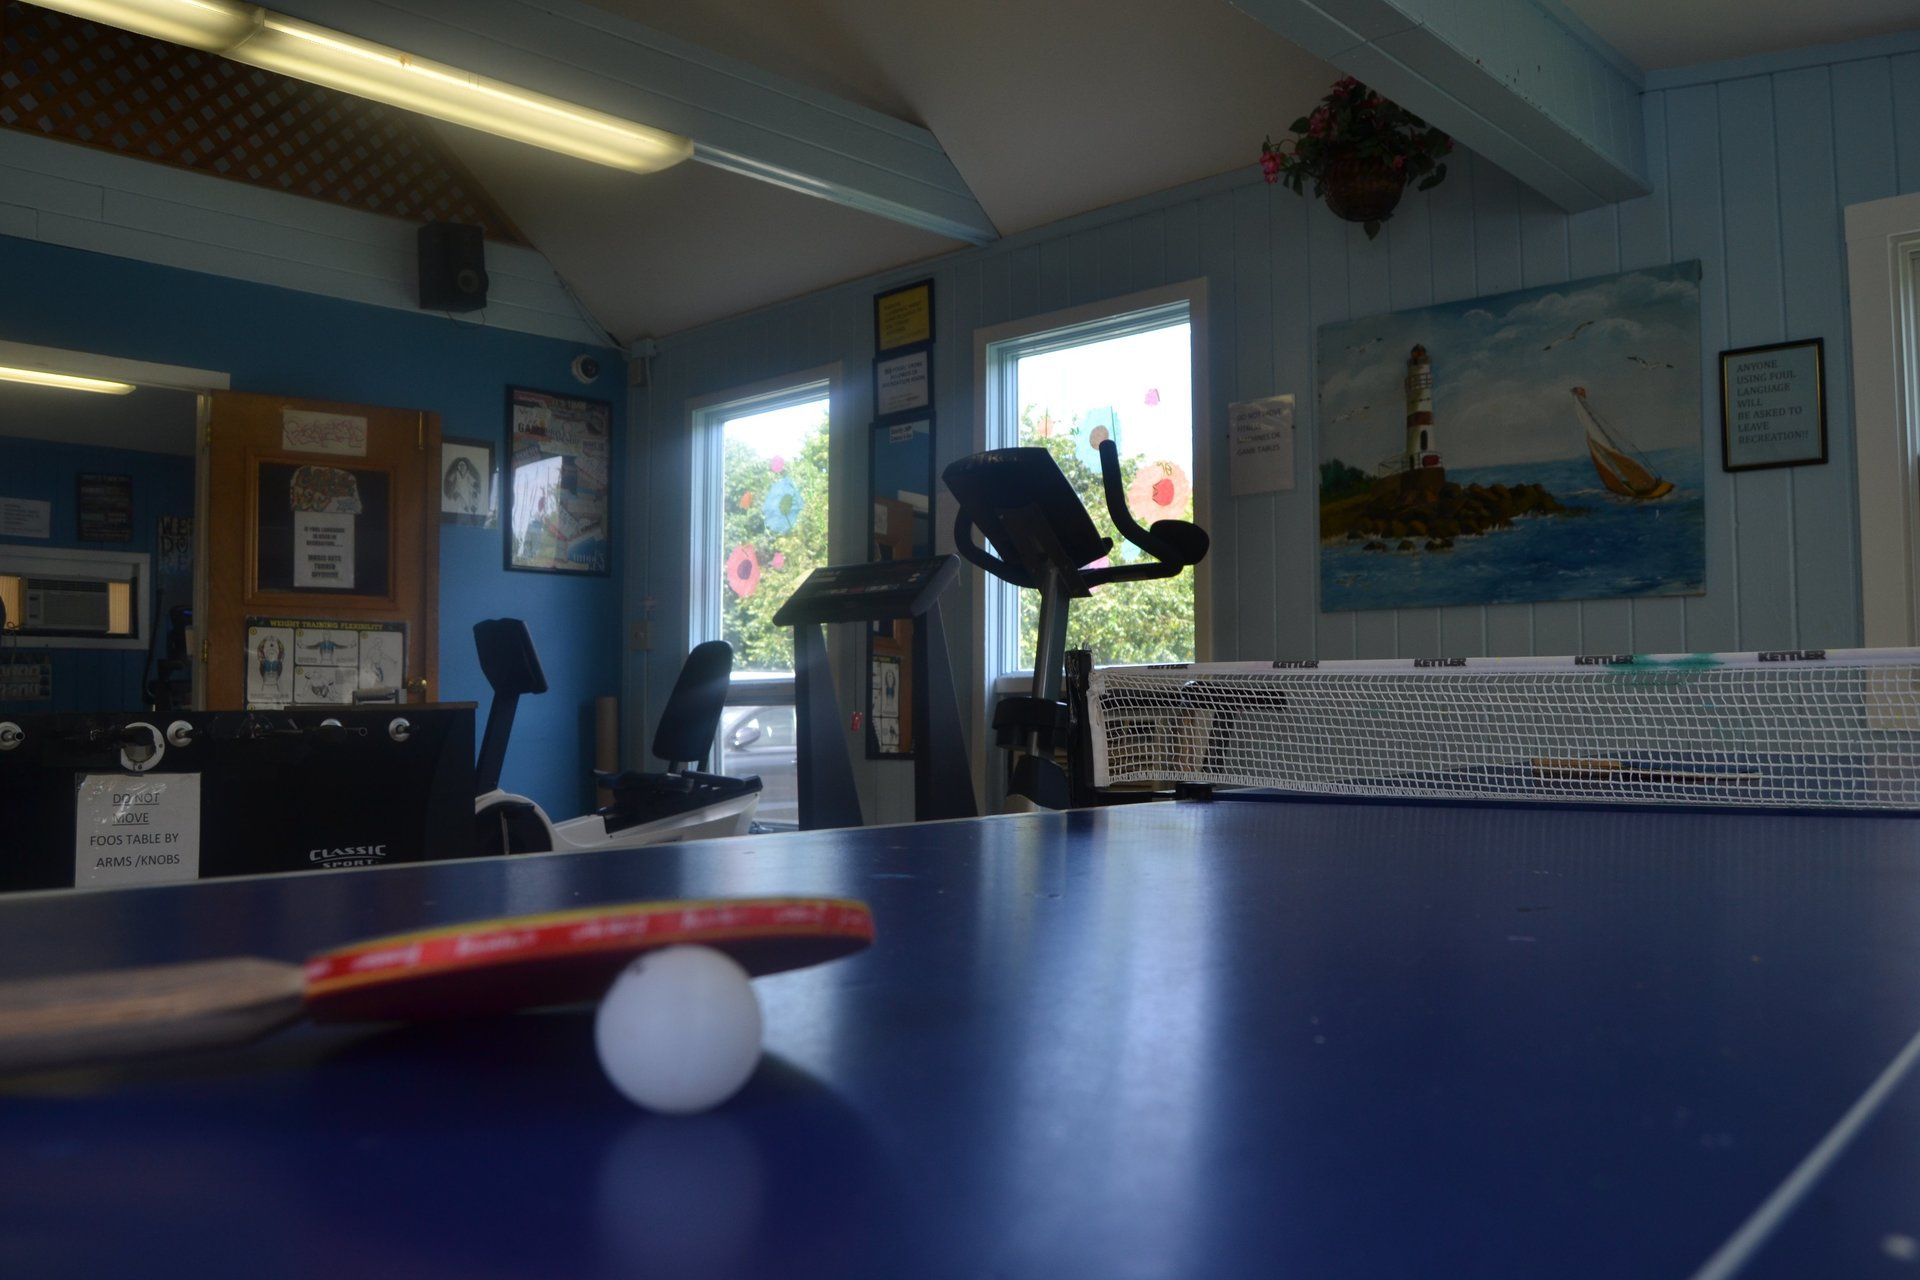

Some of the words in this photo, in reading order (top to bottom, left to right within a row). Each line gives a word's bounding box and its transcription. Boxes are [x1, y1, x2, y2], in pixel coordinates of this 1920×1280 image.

[1737, 359, 1778, 373] ANYONE
[1737, 372, 1767, 384] USING
[1769, 370, 1797, 381] FOUL
[1737, 383, 1791, 397] LANGUAGE
[1737, 398, 1764, 408] WILL
[1738, 411, 1751, 421] BE
[1753, 407, 1786, 419] ASKED
[1788, 406, 1802, 415] TO
[1738, 421, 1769, 433] LEAVE
[270, 619, 301, 628] WEIGHT
[302, 621, 338, 629] TRAINING
[341, 622, 384, 630] FLEXIBILITY
[1574, 655, 1634, 666] KETTLER
[1758, 650, 1826, 662] KETTLER
[1272, 660, 1320, 669] KETTLER
[1413, 658, 1467, 667] KETTLER
[113, 793, 131, 804] DO
[134, 792, 159, 804] NOT
[90, 834, 123, 846] FOOS
[126, 833, 161, 845] TABLE
[165, 832, 179, 843] BY
[309, 844, 387, 862] CLASSIC
[96, 856, 132, 867] ARMS
[135, 854, 180, 868] /KNOBS
